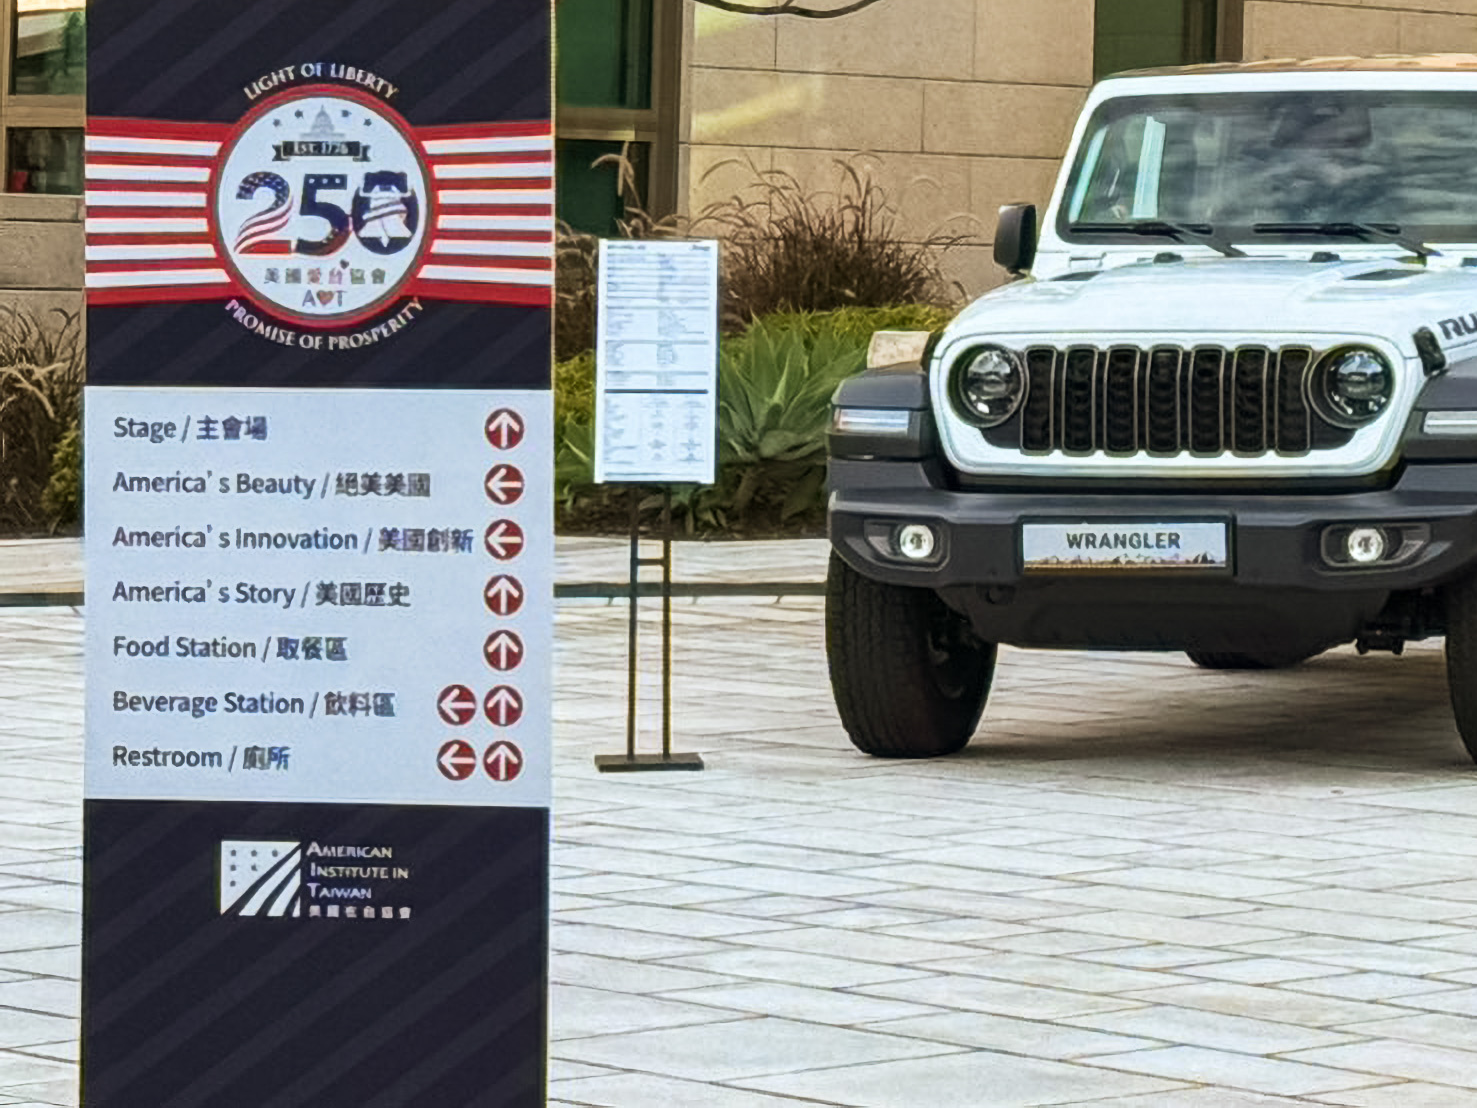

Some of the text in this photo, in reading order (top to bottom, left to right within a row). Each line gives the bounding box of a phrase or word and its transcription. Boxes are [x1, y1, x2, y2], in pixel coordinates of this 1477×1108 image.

[243, 62, 399, 100] LIGHT OF LIBERTY
[233, 170, 420, 256] 250
[225, 296, 424, 351] PROMISE OF PROSPERITY
[113, 416, 177, 444] Stage
[236, 473, 317, 500] Beauty
[235, 526, 359, 550] Innovation
[1066, 532, 1181, 549] WRANGLER
[235, 581, 297, 610] Story
[113, 635, 170, 657] Food
[175, 635, 257, 659] Station
[113, 690, 218, 719] Beverage
[223, 690, 305, 714] Station
[112, 745, 223, 768] Restroom
[306, 841, 393, 858] AMERICAN
[310, 862, 409, 879] INSTITUTE IN
[306, 882, 372, 899] TAIWAN
